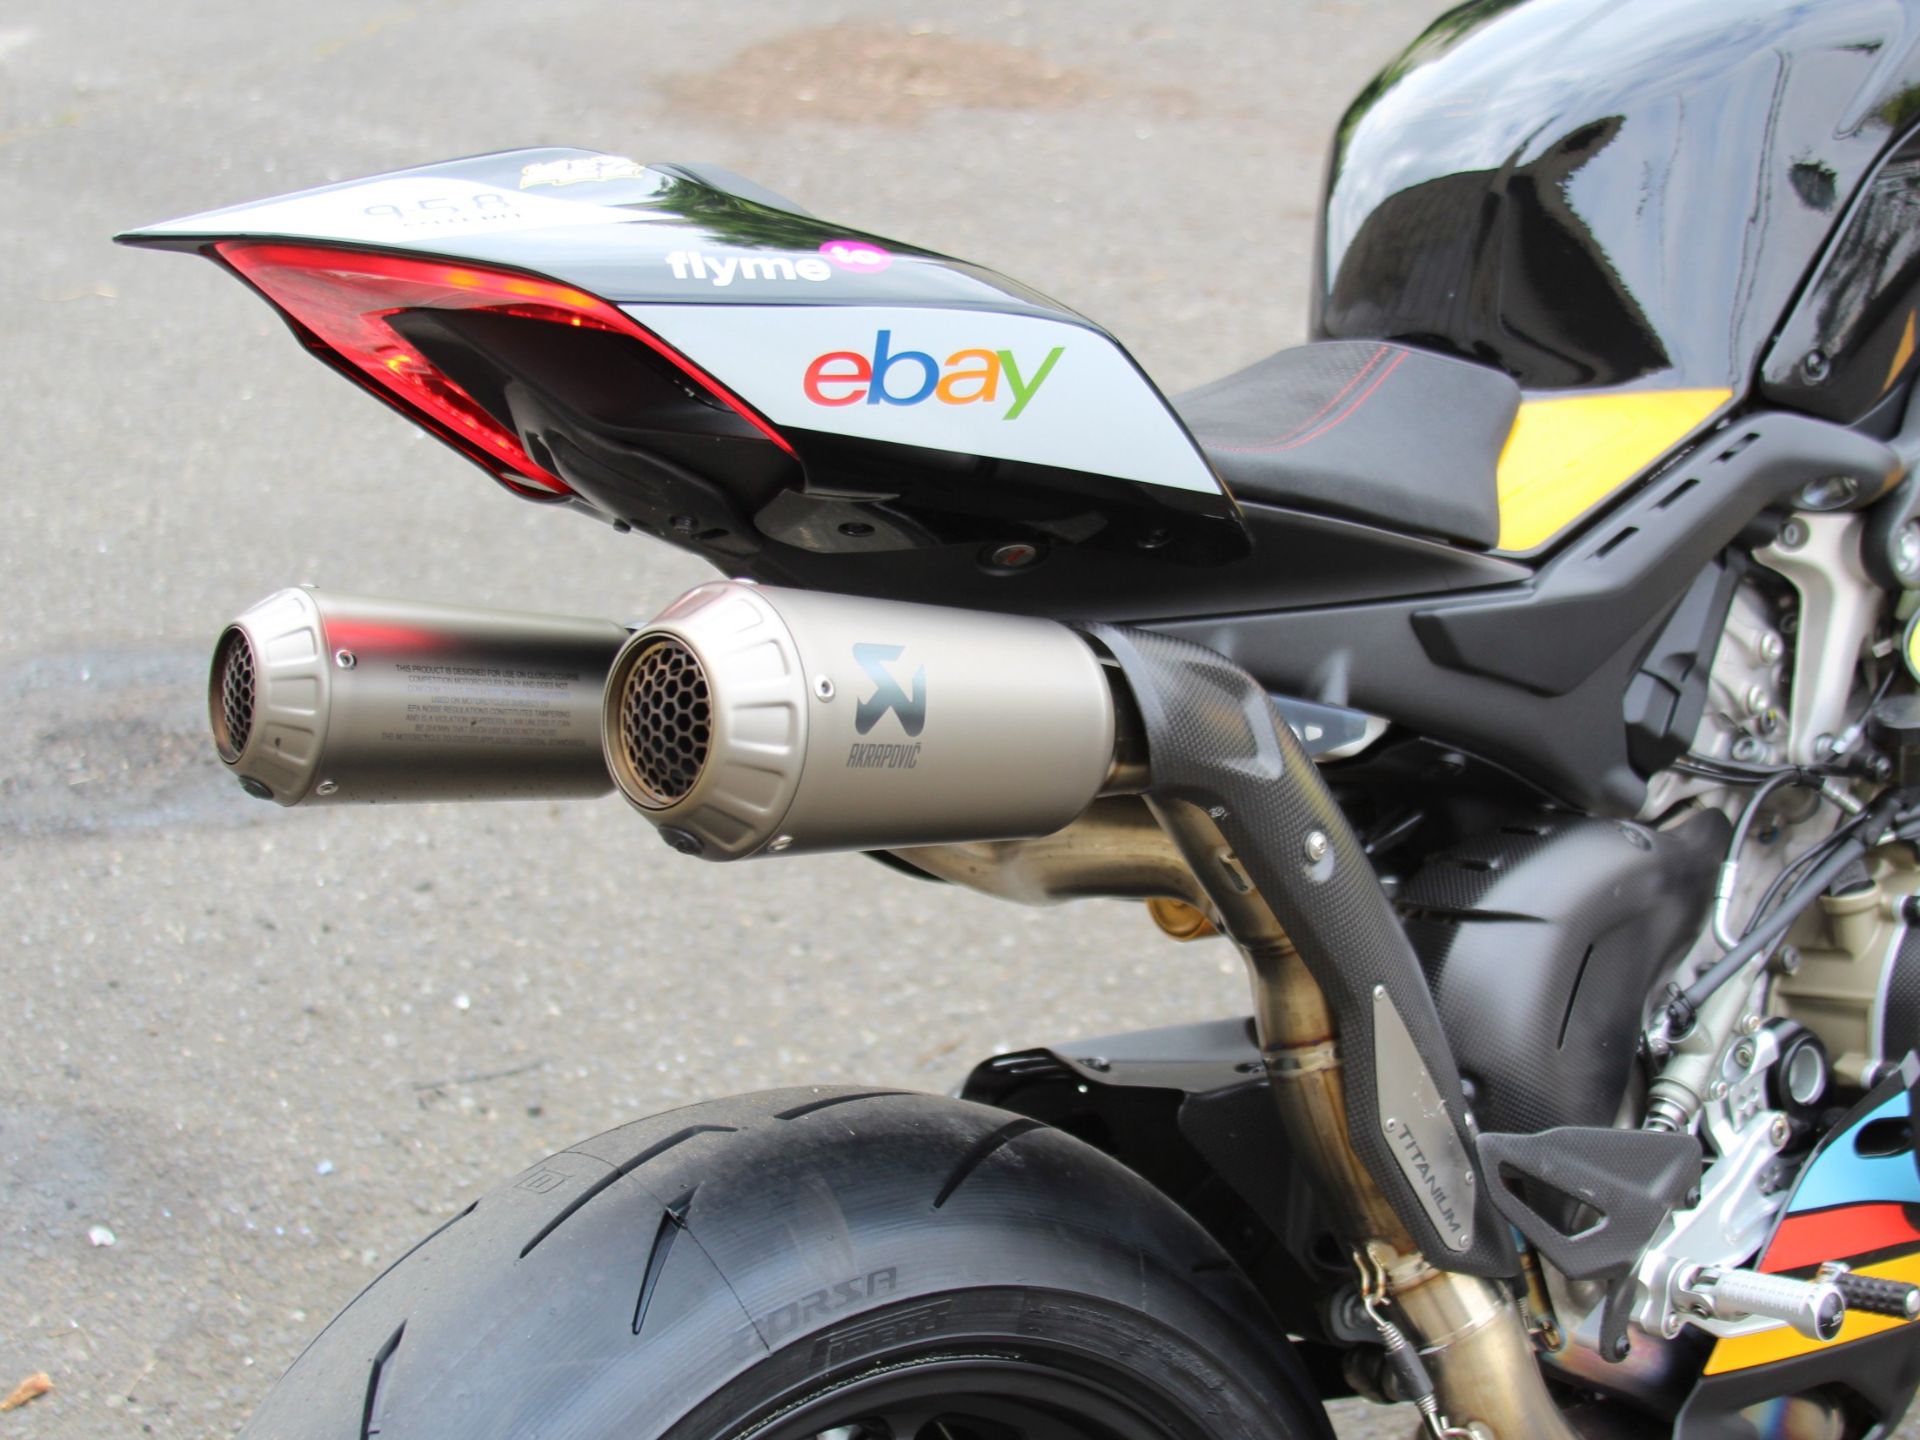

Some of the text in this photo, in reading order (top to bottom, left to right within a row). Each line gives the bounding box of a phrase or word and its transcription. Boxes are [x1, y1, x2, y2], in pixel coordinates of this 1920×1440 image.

[665, 250, 831, 286] flyme
[803, 330, 1066, 420] ebay
[395, 664, 411, 673] THIS
[412, 665, 444, 674] PRODUCT
[453, 667, 486, 677] DESIGNED
[488, 669, 500, 677] FOR
[503, 670, 514, 678] USE
[555, 682, 569, 690] NOT
[1398, 1123, 1461, 1233] TITANIUM
[744, 1266, 898, 1345] ORSA
